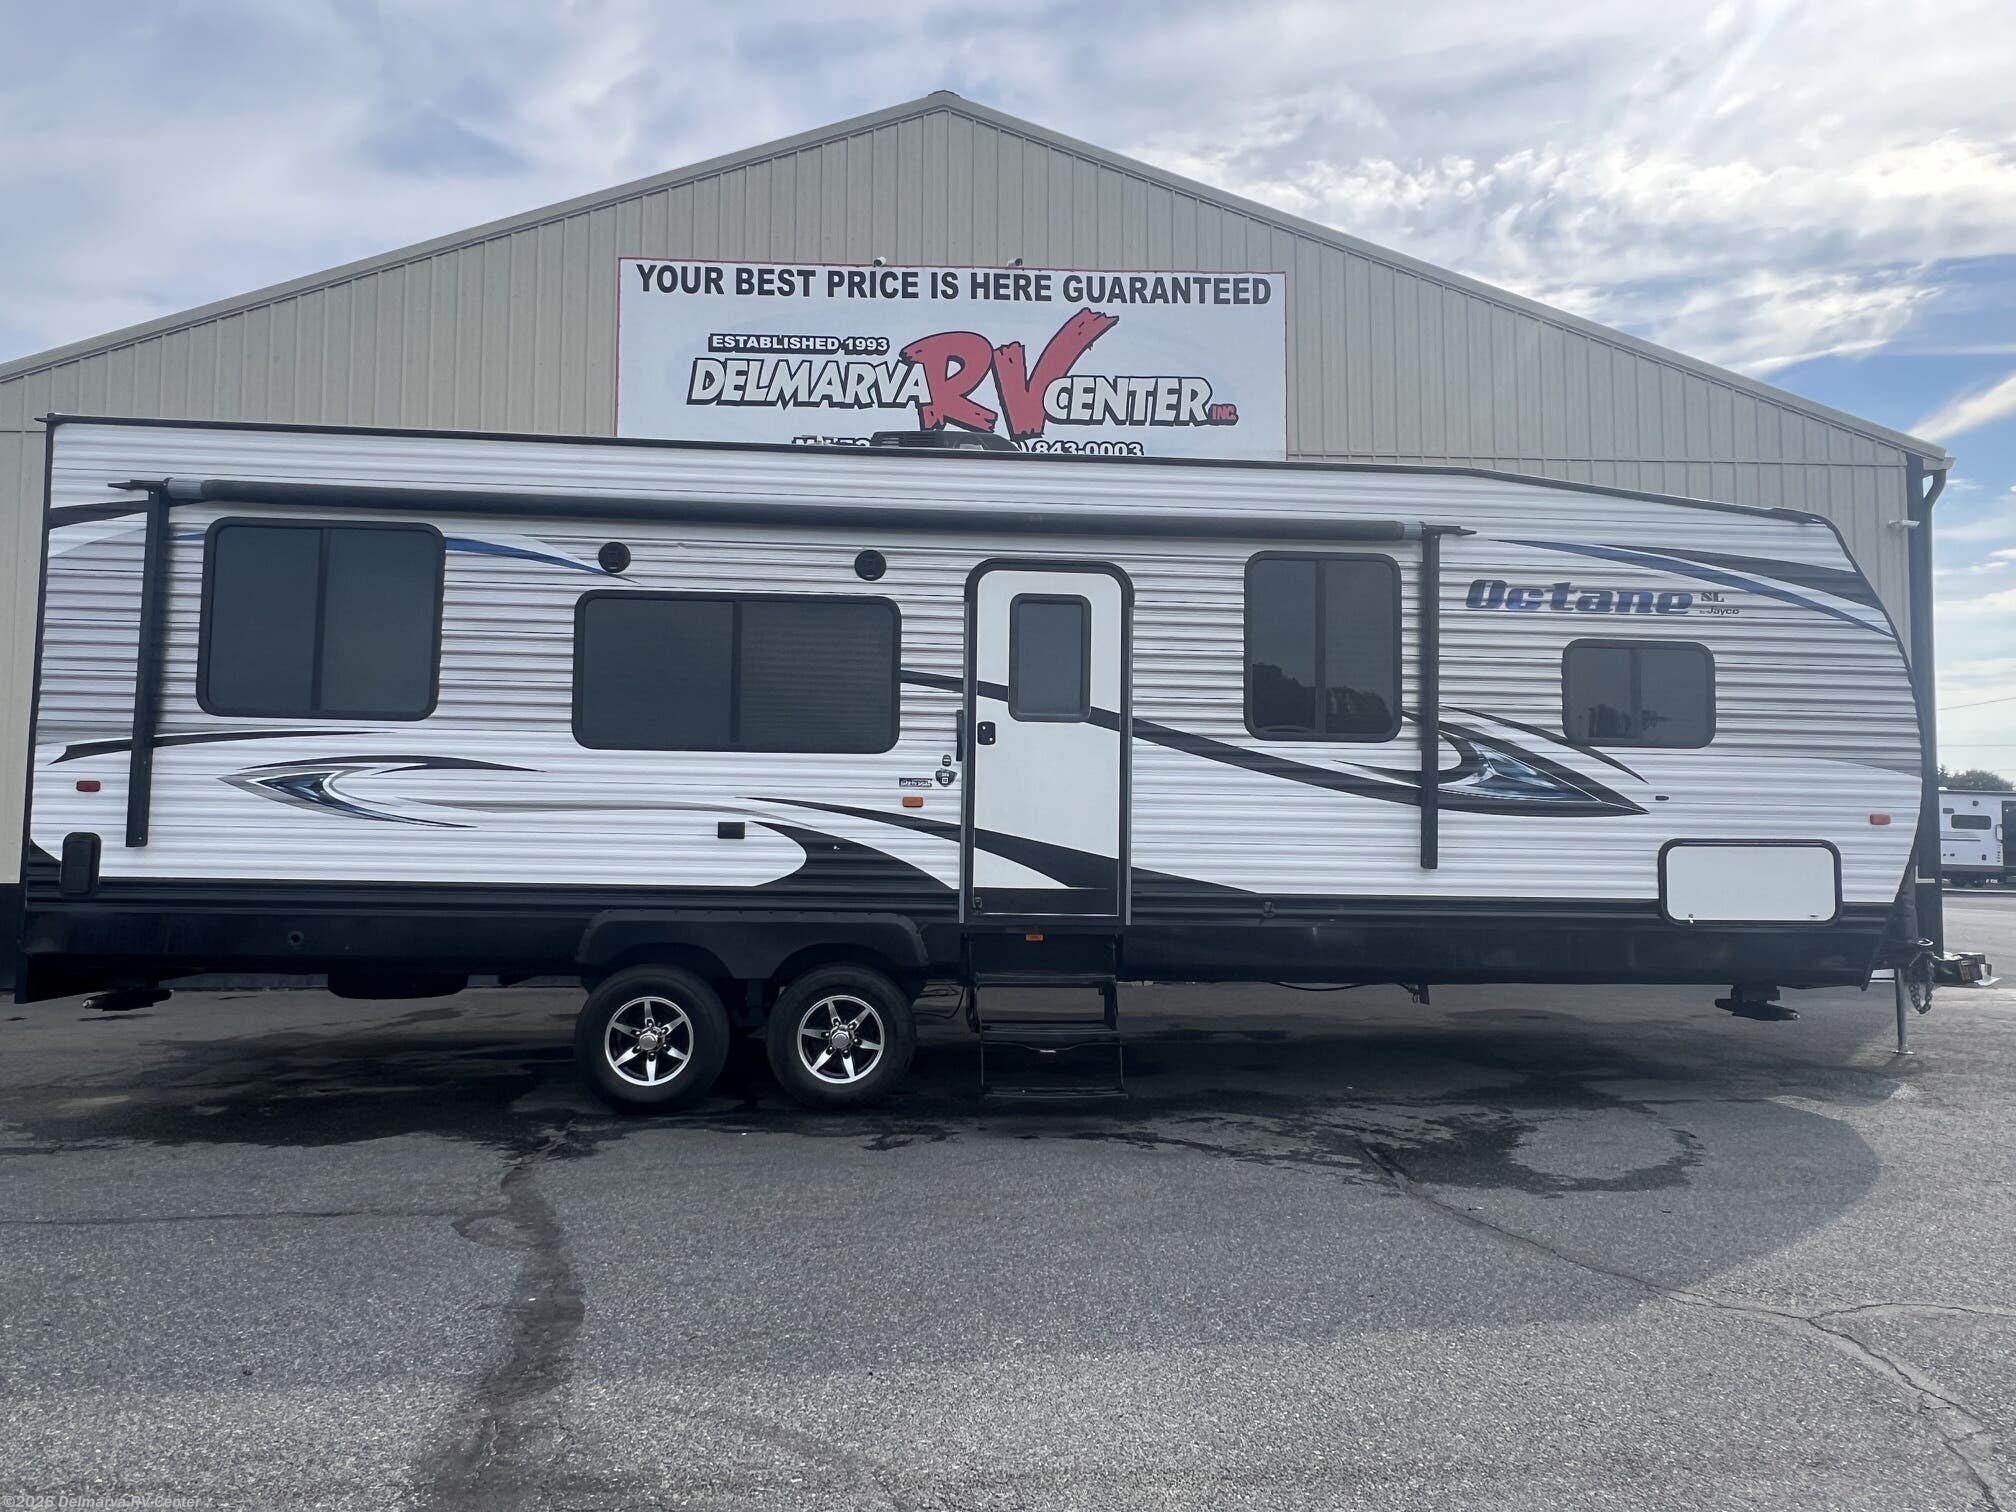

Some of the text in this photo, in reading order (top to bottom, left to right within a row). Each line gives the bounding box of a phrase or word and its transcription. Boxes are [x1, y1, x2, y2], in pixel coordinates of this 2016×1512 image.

[637, 264, 1272, 305] YOUR BEST PRICE IS HERE GUARANTEED
[711, 334, 888, 351] ESTABLISHED 1993
[687, 358, 933, 409] DELMARVA
[899, 307, 1119, 441] RV
[1043, 375, 1212, 426] CENTER
[1466, 579, 1725, 614] Octane SL
[1707, 607, 1740, 615] Jayco
